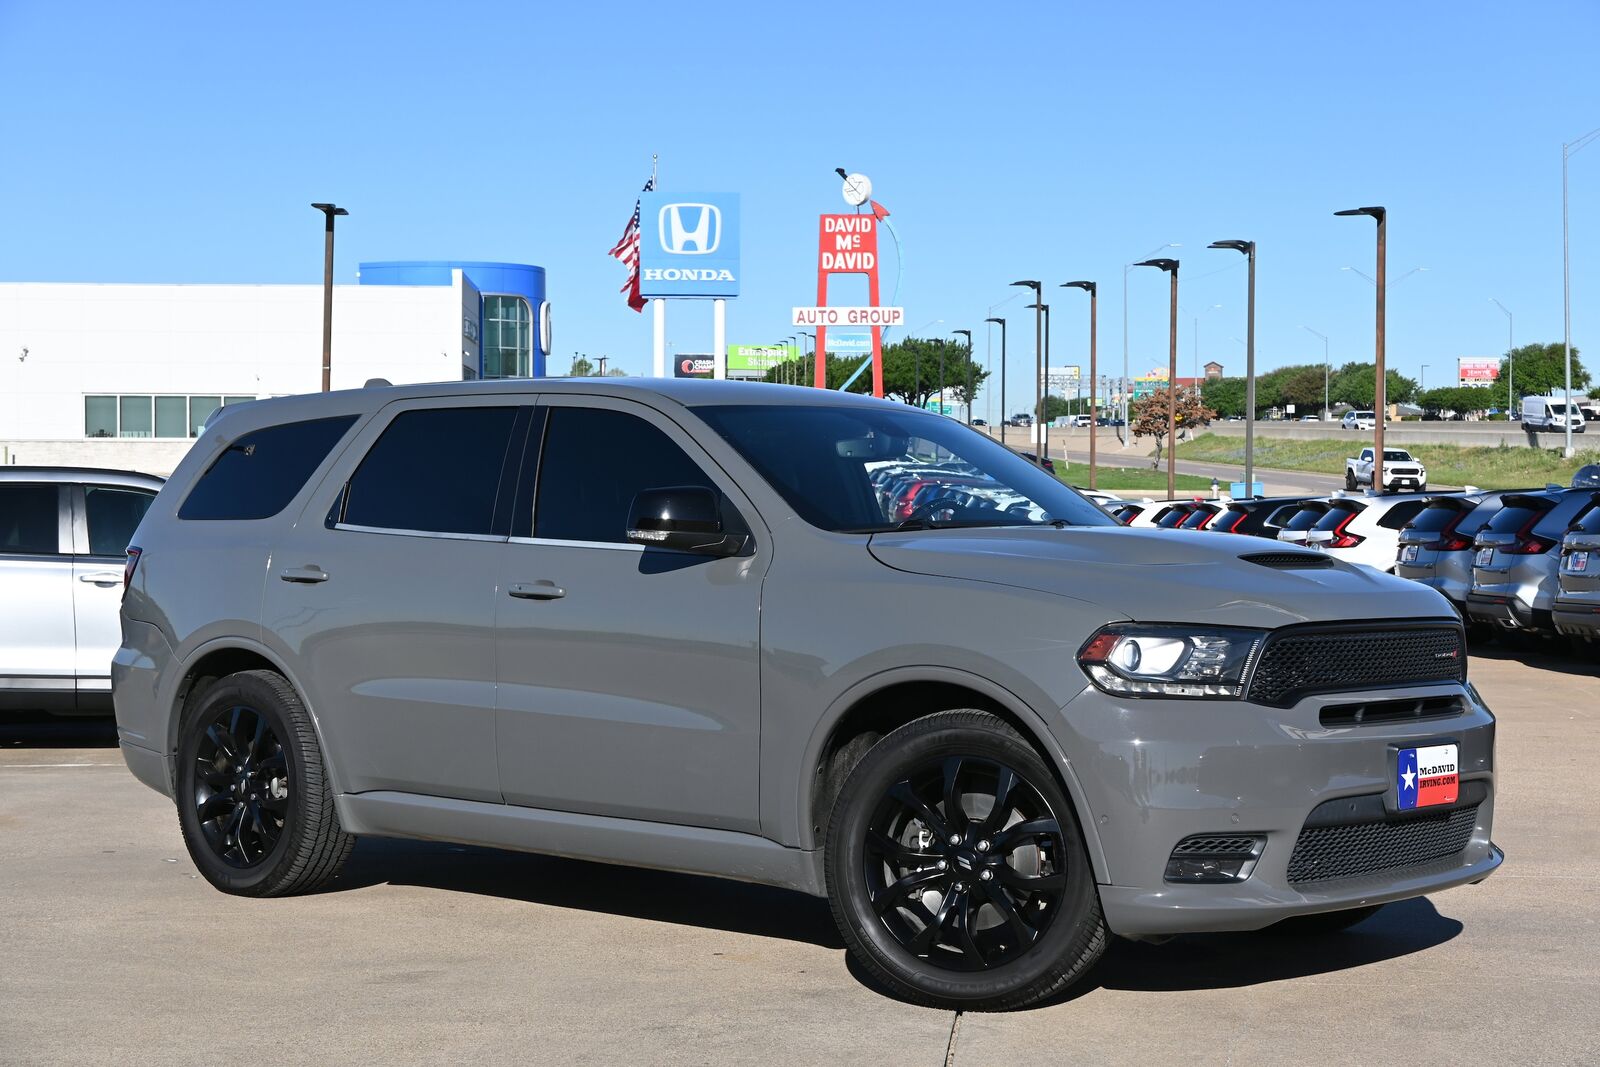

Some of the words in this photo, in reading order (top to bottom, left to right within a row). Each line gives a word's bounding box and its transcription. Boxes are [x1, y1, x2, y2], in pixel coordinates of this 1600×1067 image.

[825, 218, 872, 233] DAVID
[822, 252, 875, 270] DAVID
[643, 268, 736, 281] HONDA
[796, 310, 838, 324] AUTO
[848, 309, 901, 324] GROUP
[1419, 764, 1455, 776] McDAVID
[1419, 776, 1456, 788] IRVING.COM
